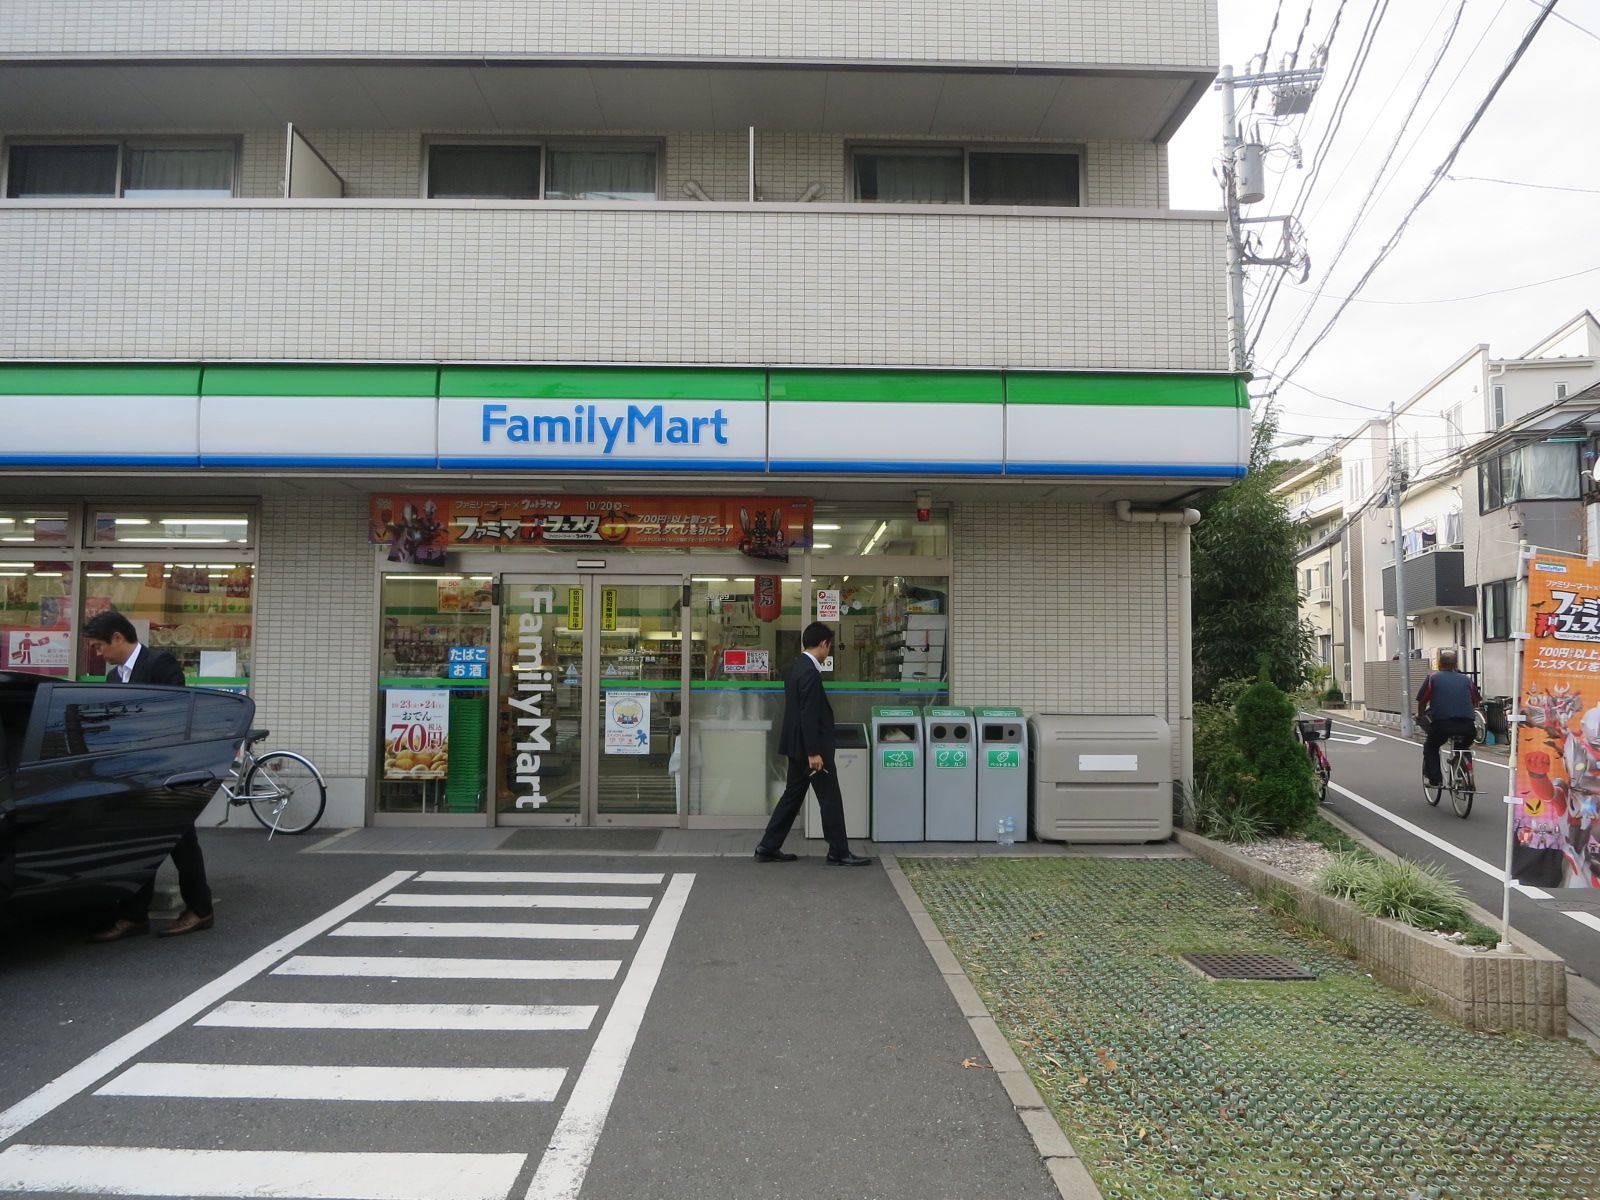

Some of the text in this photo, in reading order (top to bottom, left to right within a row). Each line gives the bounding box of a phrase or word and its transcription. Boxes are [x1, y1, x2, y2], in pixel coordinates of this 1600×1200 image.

[482, 404, 728, 454] FamilyMart
[1551, 590, 1600, 615] ファミ
[450, 648, 486, 661] たばこ
[453, 664, 482, 677] お酒
[508, 591, 553, 809] FamilyMart
[402, 711, 432, 721] おでん
